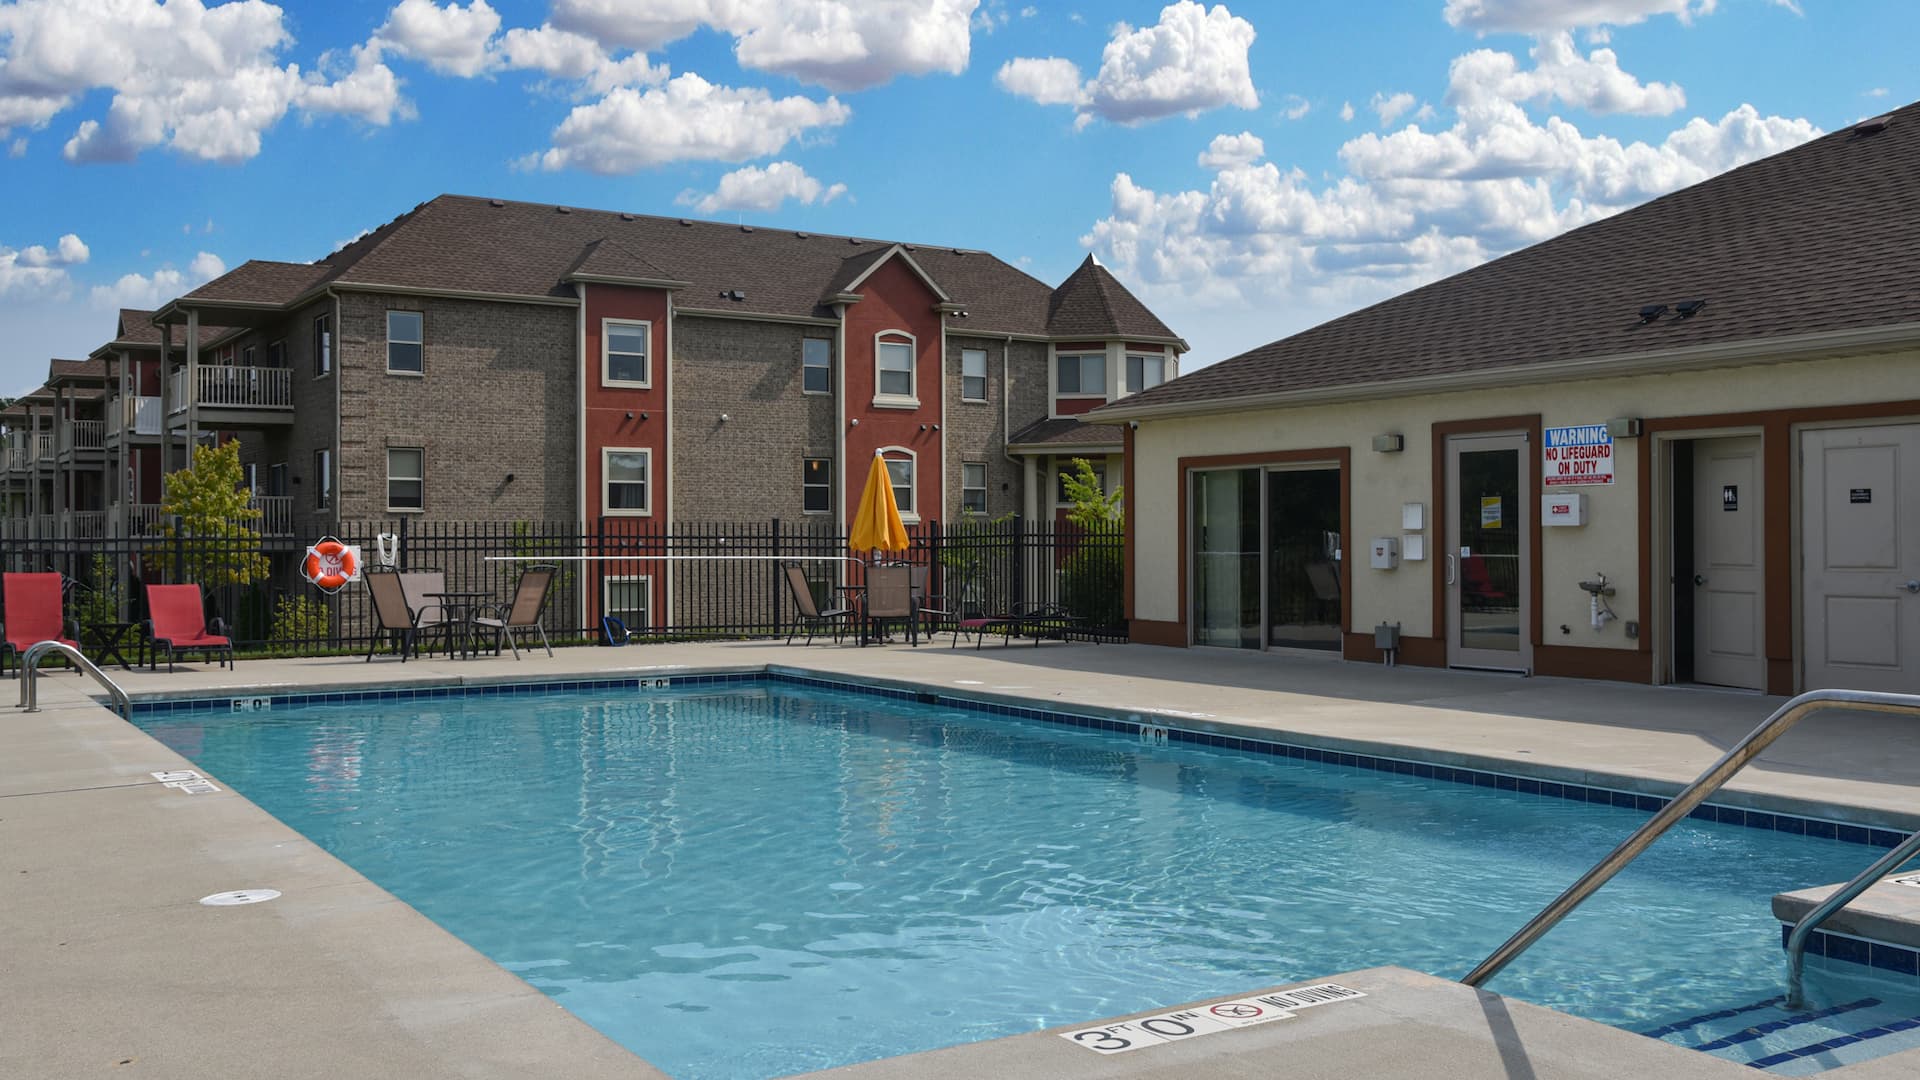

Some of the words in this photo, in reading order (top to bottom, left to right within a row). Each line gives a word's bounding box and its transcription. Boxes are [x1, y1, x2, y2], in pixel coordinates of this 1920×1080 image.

[1550, 427, 1608, 446] WARNING
[1546, 447, 1558, 461] NO
[1562, 445, 1610, 460] LIFEGUARD
[1558, 461, 1570, 475] ON
[1574, 460, 1597, 474] DUTY
[327, 567, 357, 577] DIVG
[1256, 995, 1300, 1009] NO
[1285, 985, 1357, 1003] DIVING
[1074, 1031, 1131, 1050] 3
[1104, 1023, 1132, 1034] FT
[1141, 1019, 1195, 1036] 0
[1170, 1012, 1199, 1021] IN
